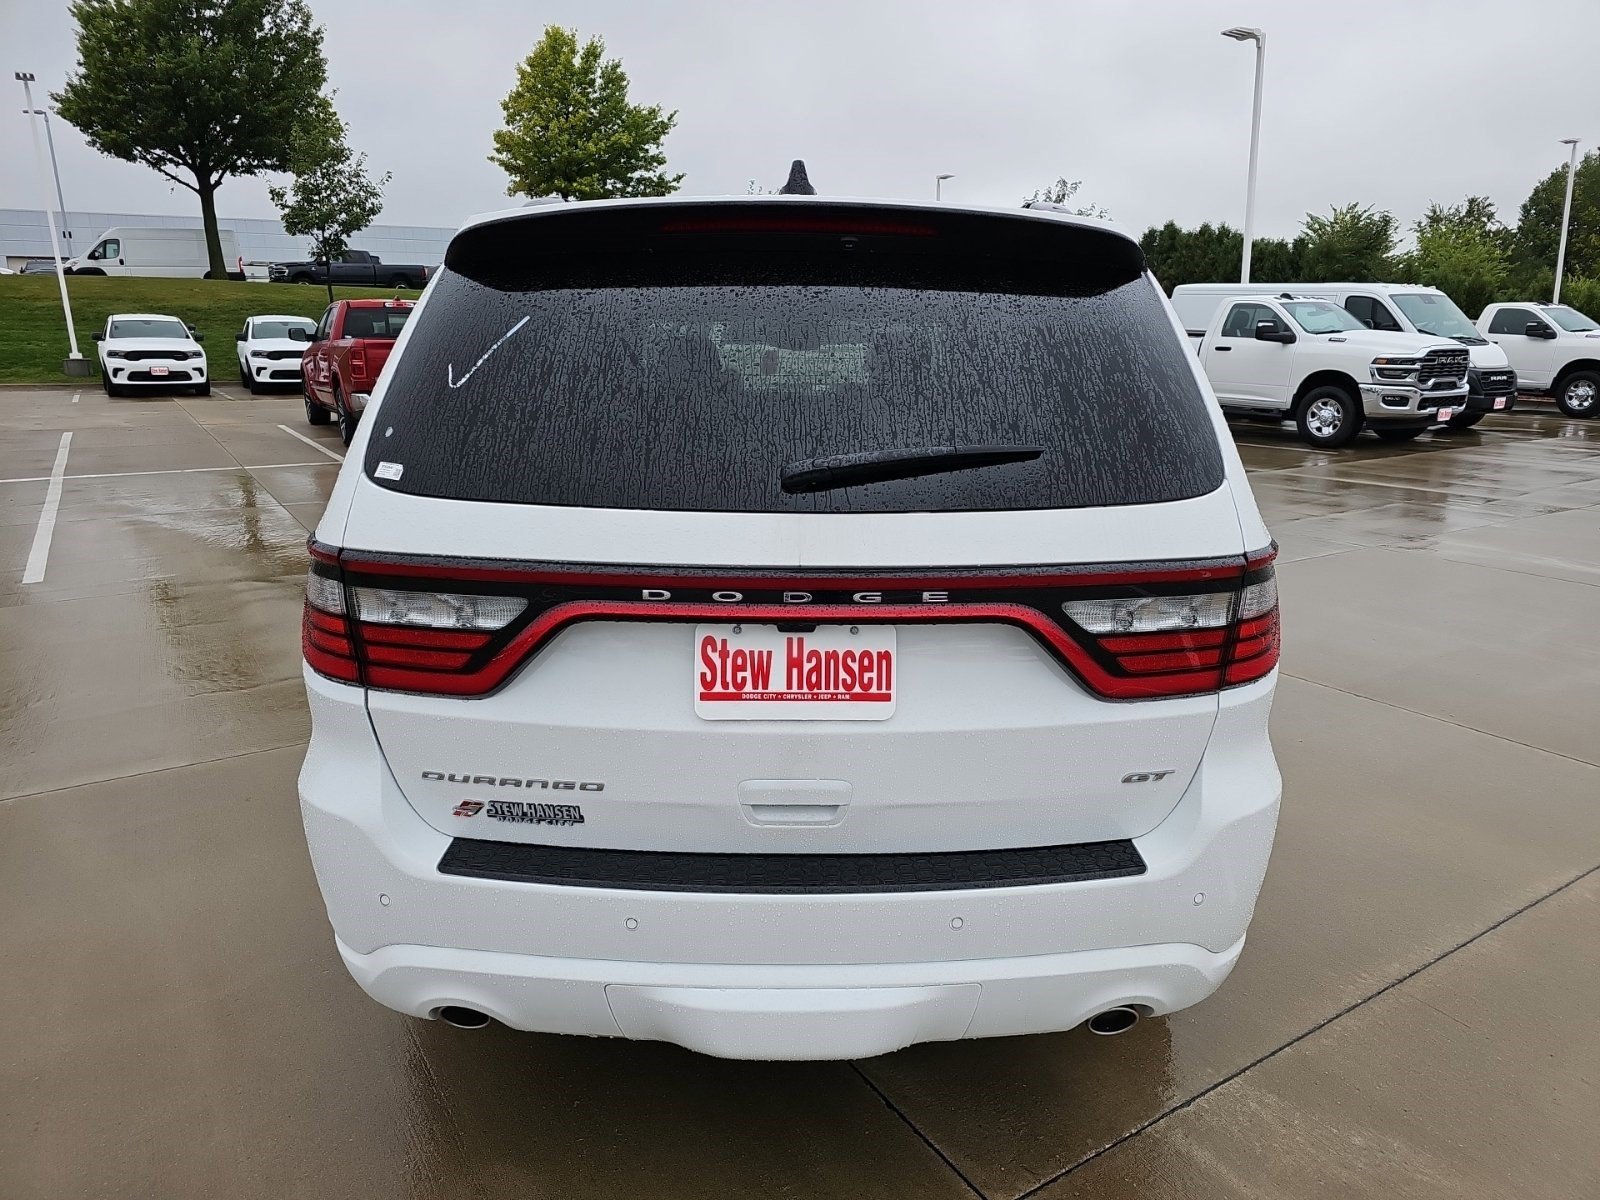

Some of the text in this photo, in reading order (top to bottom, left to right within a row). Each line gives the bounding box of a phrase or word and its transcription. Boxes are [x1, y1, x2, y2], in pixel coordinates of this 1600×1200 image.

[642, 589, 949, 603] DODGE
[700, 635, 892, 692] Stew Hansen
[421, 770, 606, 792] DURANGO
[1121, 769, 1176, 783] GT
[487, 801, 581, 820] STEW HANSEN
[496, 816, 575, 827] DODGE CITY
